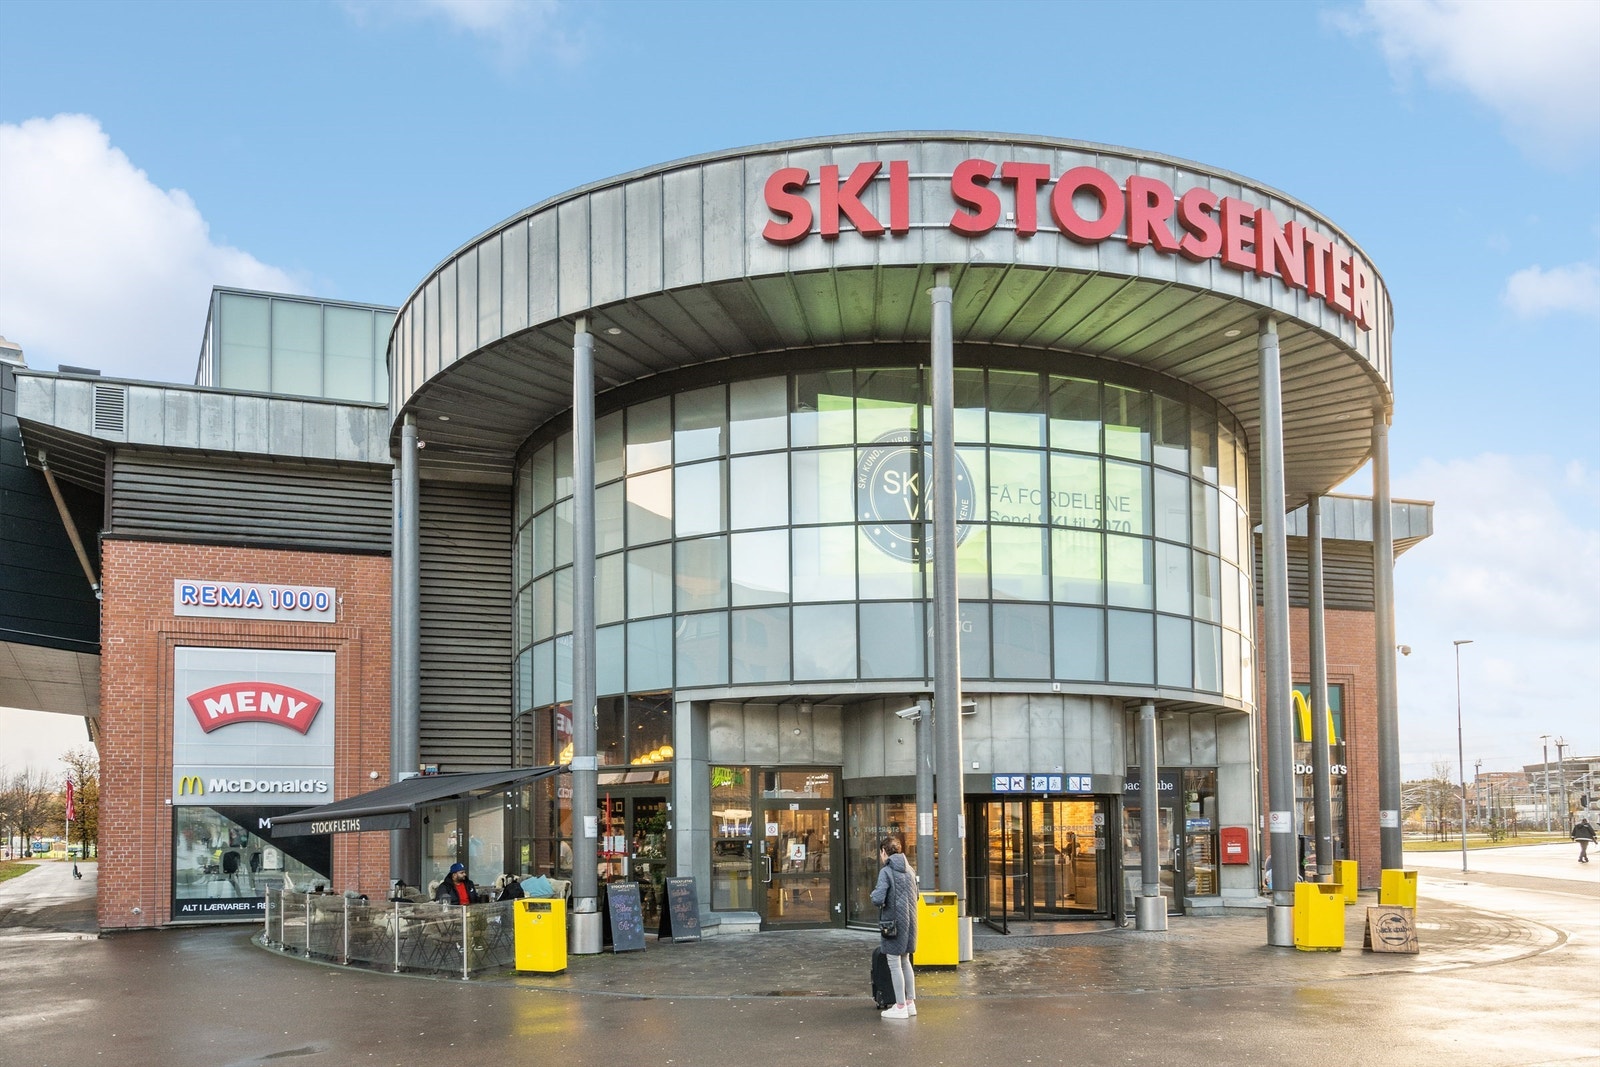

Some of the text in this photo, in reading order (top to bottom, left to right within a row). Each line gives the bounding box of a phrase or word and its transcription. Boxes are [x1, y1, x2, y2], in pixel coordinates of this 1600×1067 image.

[762, 159, 1372, 332] SKI STORSENTER
[990, 484, 1131, 512] FÅ FORDELENE
[181, 584, 329, 611] REMA 1000
[203, 691, 308, 719] MENY
[208, 778, 328, 793] McDonald's
[311, 819, 361, 834] STOCKFLETHS
[182, 904, 198, 912] ALT
[204, 902, 250, 911] LÆRVARER
